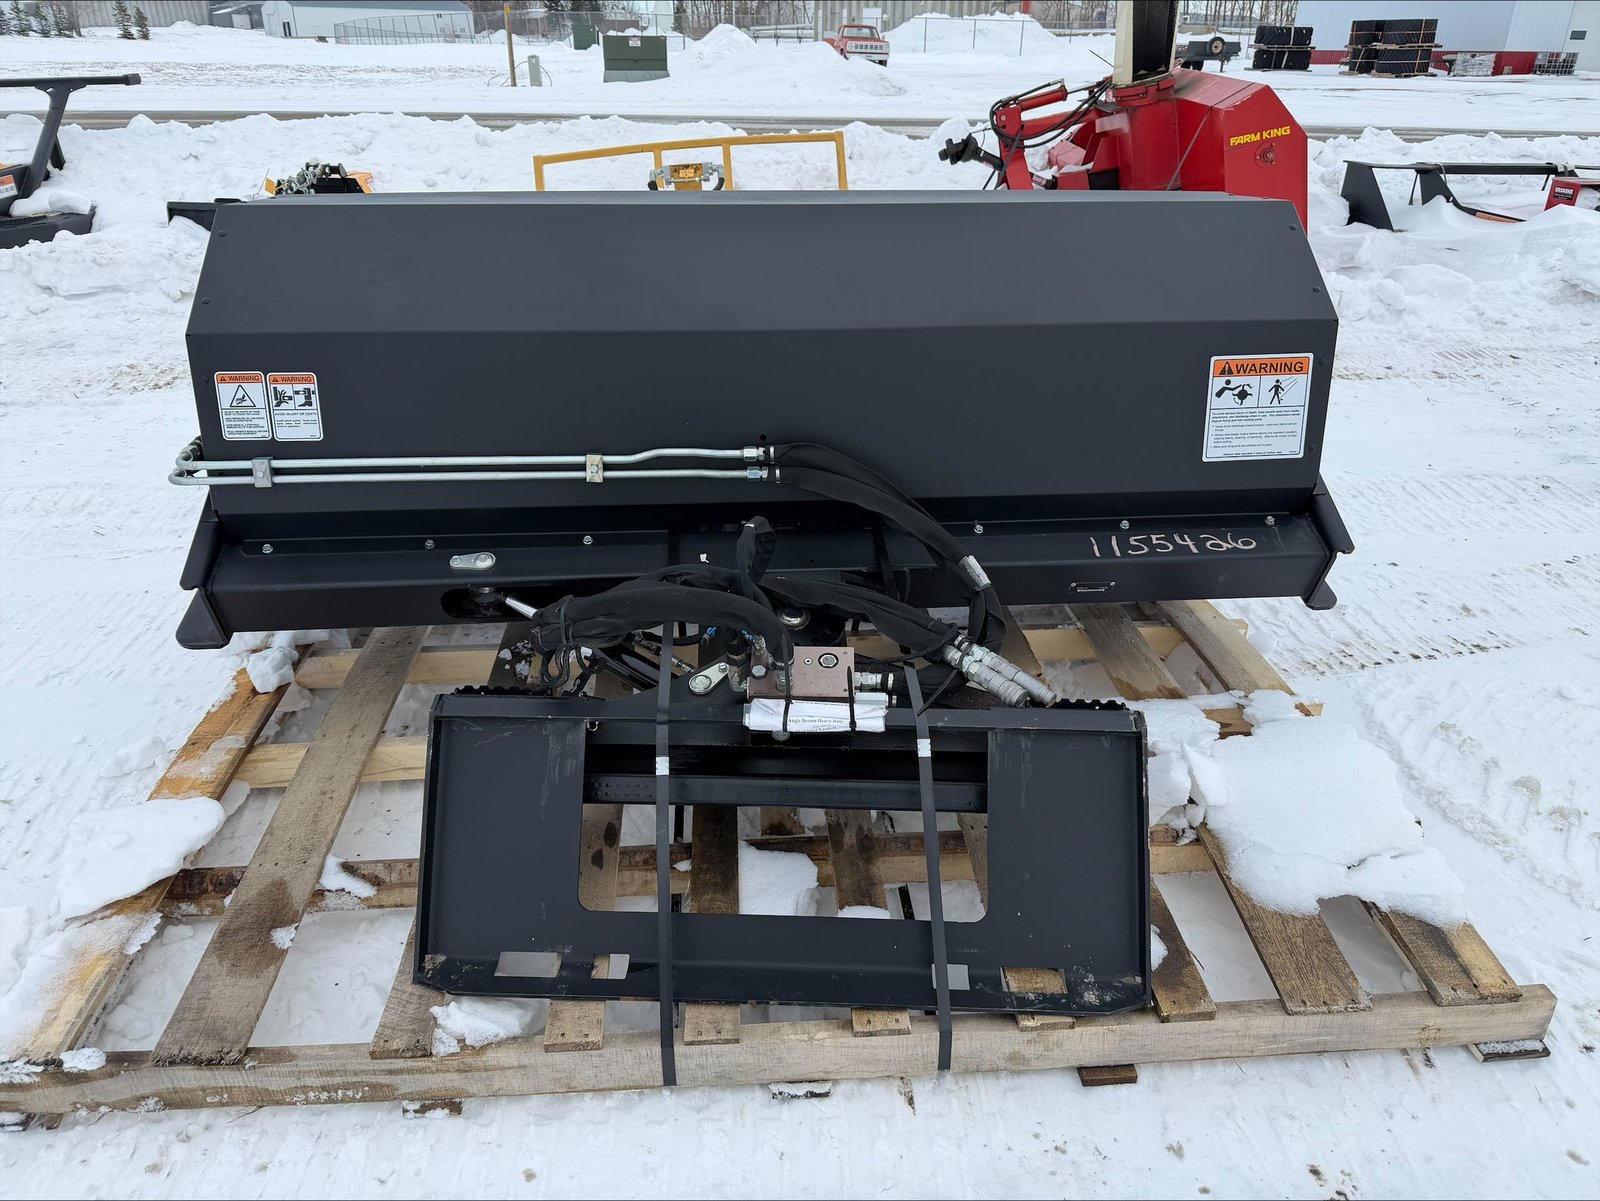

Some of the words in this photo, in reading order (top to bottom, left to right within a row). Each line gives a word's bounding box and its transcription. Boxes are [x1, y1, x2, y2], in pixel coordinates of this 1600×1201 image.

[1230, 132, 1260, 146] FARM
[1262, 125, 1291, 140] KING
[1235, 361, 1304, 375] WARNING
[1090, 533, 1257, 557] 1155426
